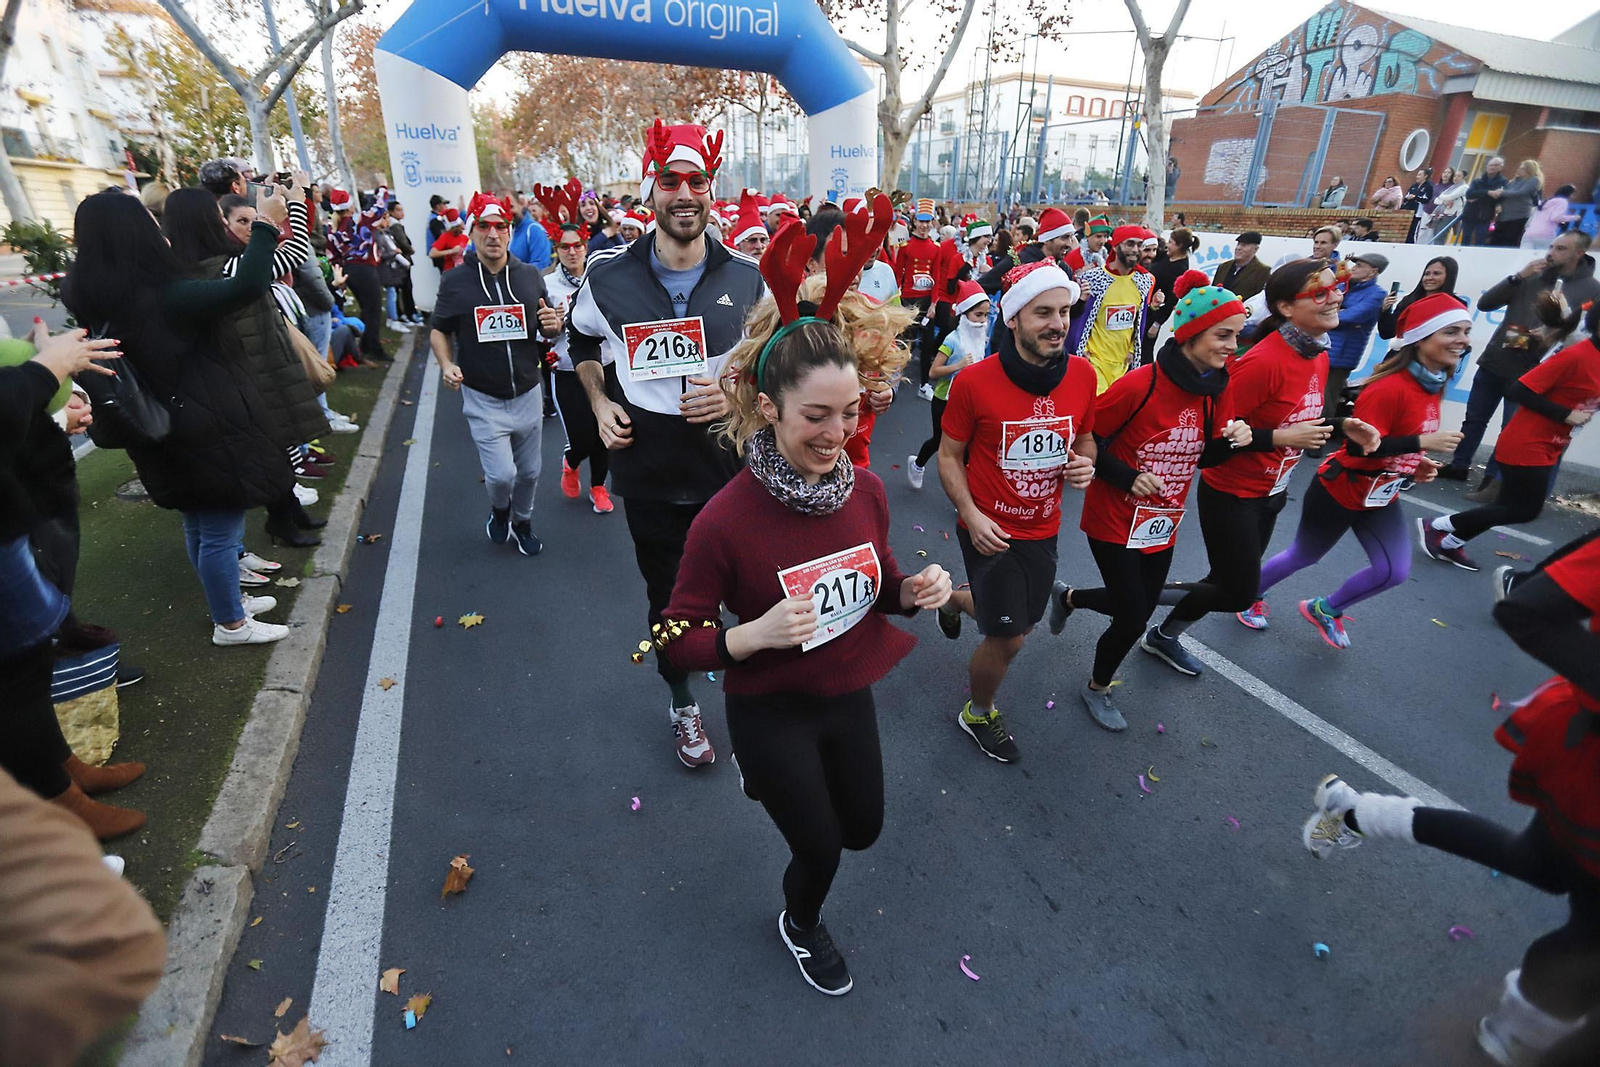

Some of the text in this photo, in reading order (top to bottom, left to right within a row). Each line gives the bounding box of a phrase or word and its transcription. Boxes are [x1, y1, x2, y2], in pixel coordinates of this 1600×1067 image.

[664, 2, 779, 39] original
[395, 123, 460, 141] Huelva
[425, 175, 462, 183] HUELVA
[488, 314, 513, 330] 215
[1115, 312, 1131, 322] 142
[645, 334, 685, 361] 216
[1022, 432, 1054, 454] 181
[1015, 478, 1058, 497] 2023
[994, 500, 1038, 516] Huelva
[1149, 519, 1166, 536] 60
[814, 571, 858, 616] 217
